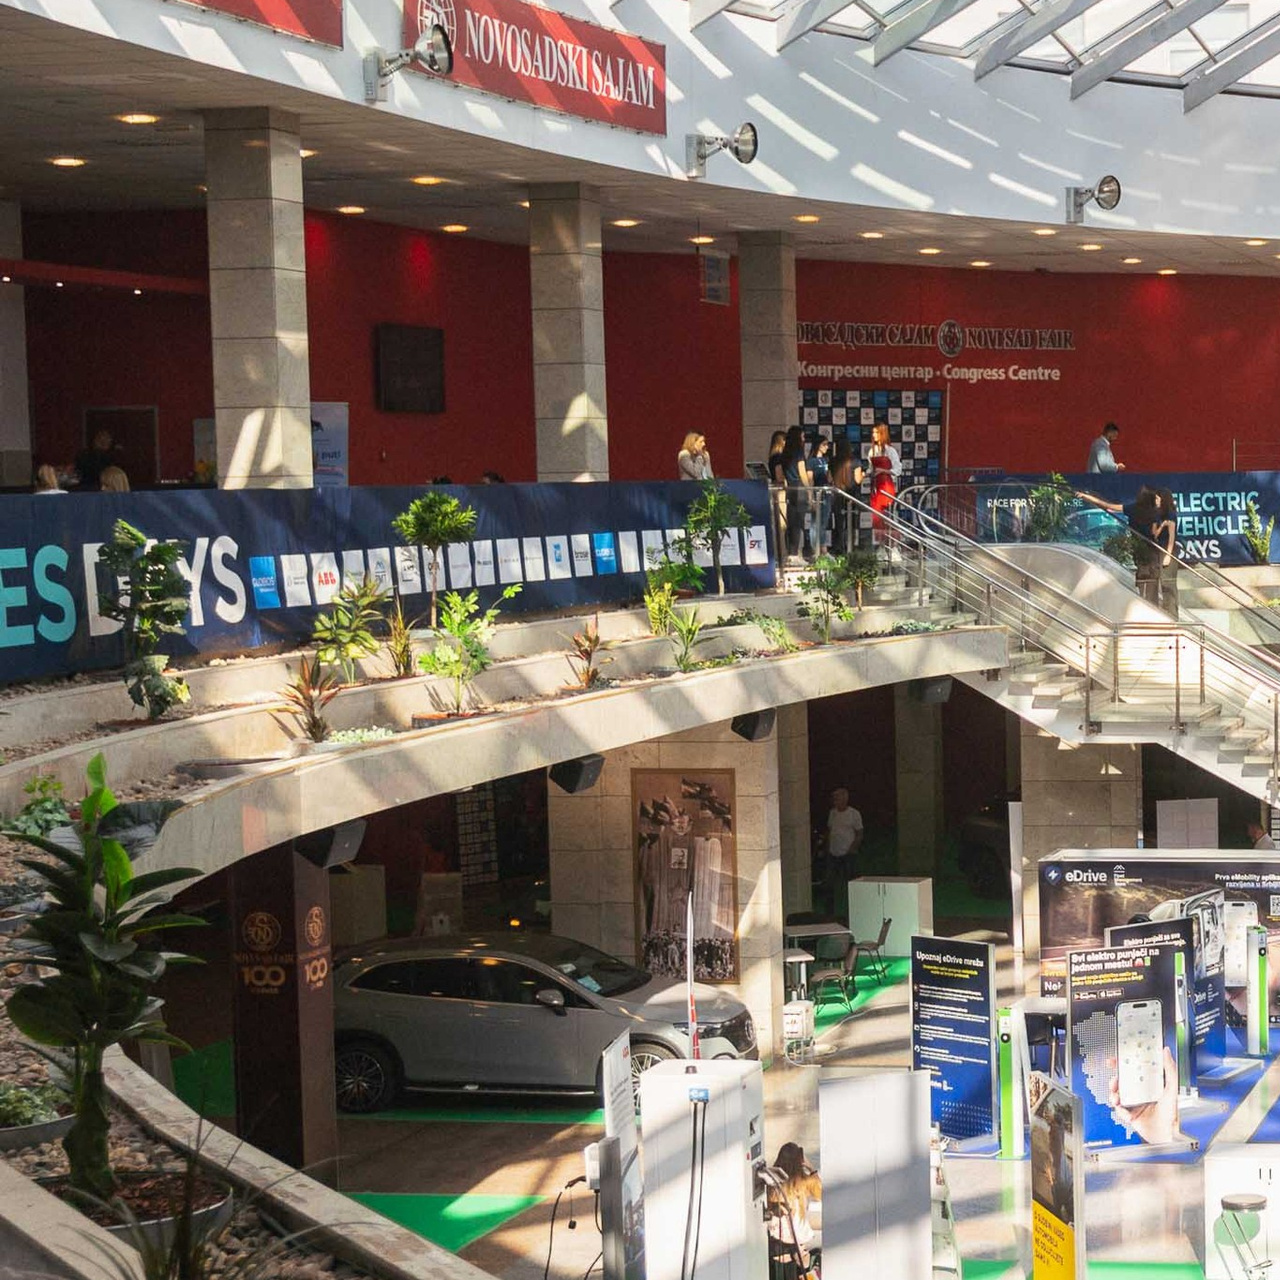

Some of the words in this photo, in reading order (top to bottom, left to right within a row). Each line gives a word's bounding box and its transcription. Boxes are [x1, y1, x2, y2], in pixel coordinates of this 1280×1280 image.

[464, 9, 589, 93] NOVOSADSKI
[592, 50, 655, 109] SAJAM
[966, 327, 1003, 349] NOVI
[798, 361, 879, 381] Конгресни
[882, 366, 934, 382] центар
[943, 363, 1009, 383] Congress
[1009, 365, 1061, 381] Centre
[987, 498, 1009, 508] RACE
[1010, 498, 1027, 508] FOR
[83, 535, 247, 637] DYS
[318, 571, 336, 586] ABB
[1065, 869, 1107, 882] eDrive
[1231, 873, 1260, 882] eMobility
[916, 951, 942, 964] Upoznaj
[942, 954, 963, 965] eDrive
[1071, 953, 1085, 963] Svi
[1087, 951, 1115, 962] elektro
[1117, 948, 1147, 960] punjači
[1149, 948, 1160, 956] na
[242, 966, 286, 986] 100
[305, 958, 328, 982] 100
[1071, 963, 1103, 974] jednom
